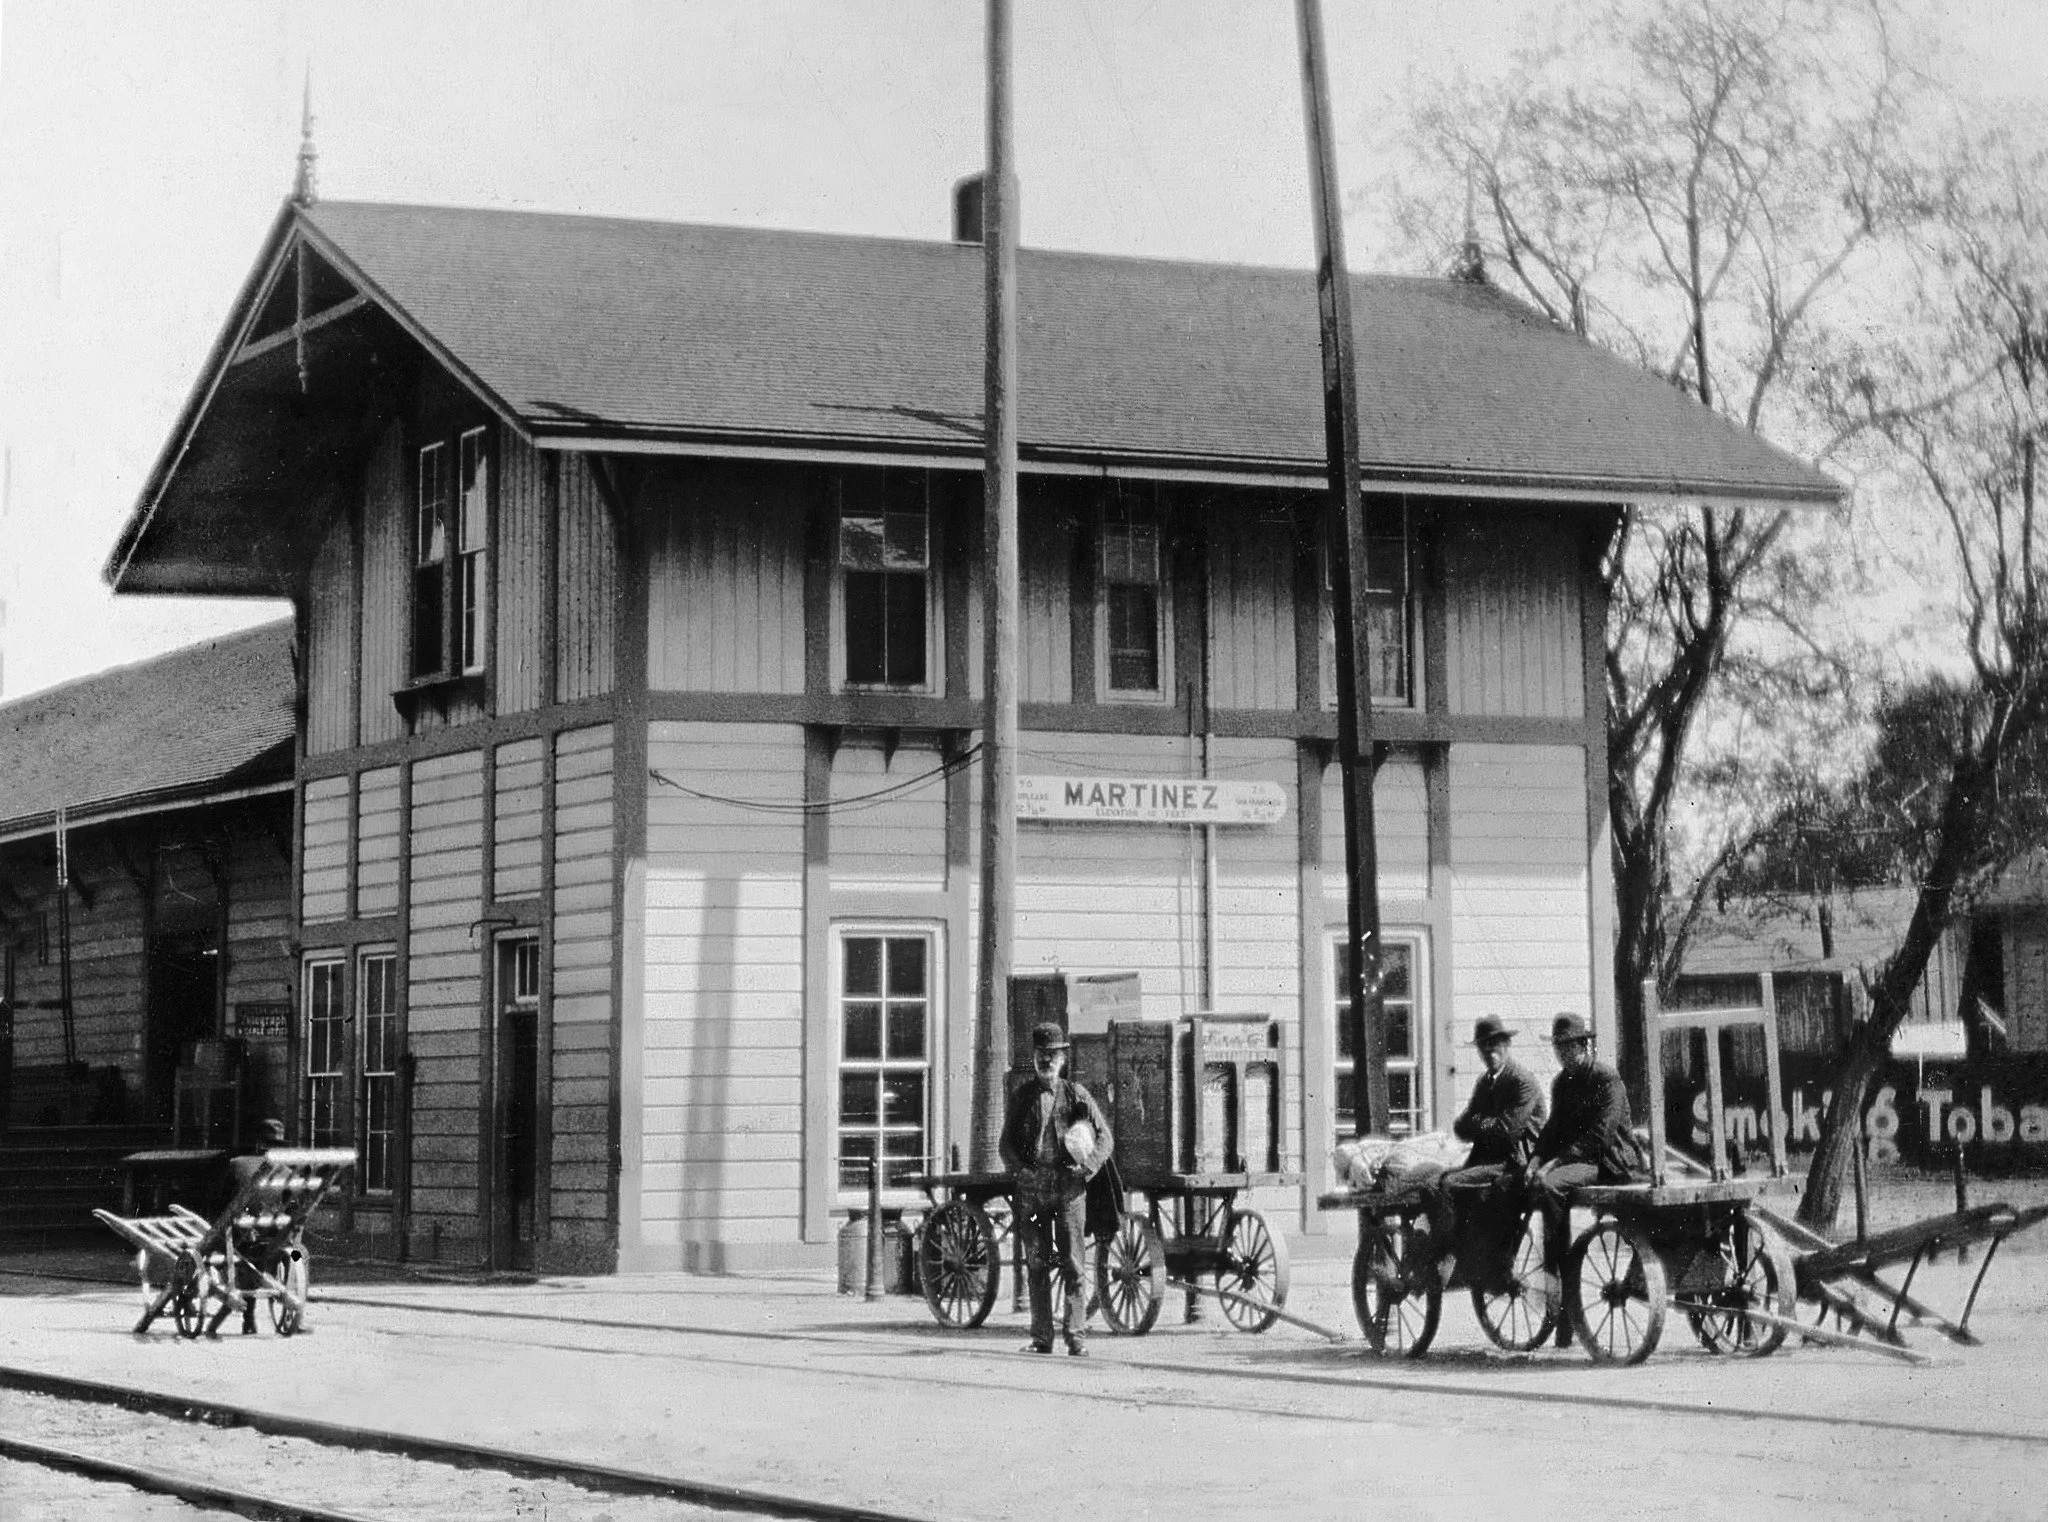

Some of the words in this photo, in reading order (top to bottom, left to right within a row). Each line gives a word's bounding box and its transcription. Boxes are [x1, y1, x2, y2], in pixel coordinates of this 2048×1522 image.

[1064, 781, 1218, 810] MARTINEZ
[1691, 1086, 1901, 1164] Smokg
[1915, 1086, 2048, 1143] Toba
